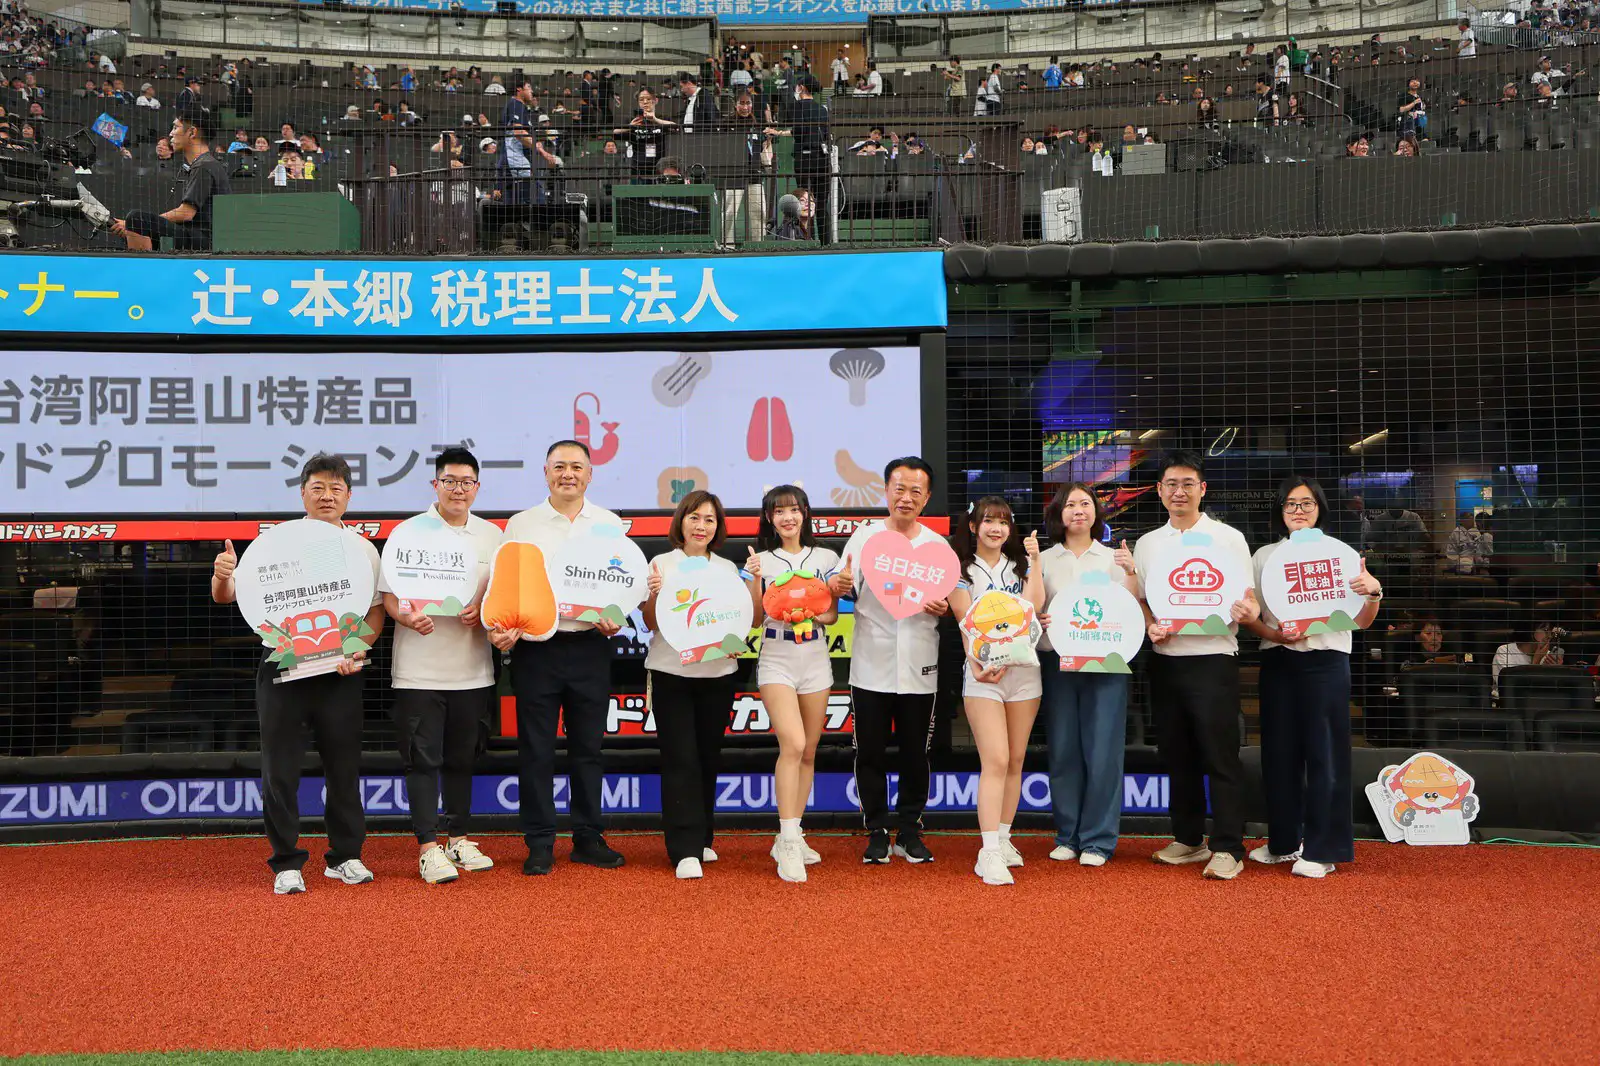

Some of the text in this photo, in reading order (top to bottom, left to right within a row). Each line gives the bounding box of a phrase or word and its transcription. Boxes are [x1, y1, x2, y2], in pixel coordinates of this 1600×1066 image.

[0, 267, 739, 328] ナー。 辻・本郷 税理士法人
[1210, 491, 1261, 500] AMERICAN
[0, 523, 117, 540] ドバシカメラ
[564, 565, 596, 580] Shin
[874, 553, 946, 585] 台日友好
[1303, 562, 1329, 576] 東和
[263, 579, 351, 605] 台湾阿里山特産品
[1288, 590, 1336, 604] DONG HE
